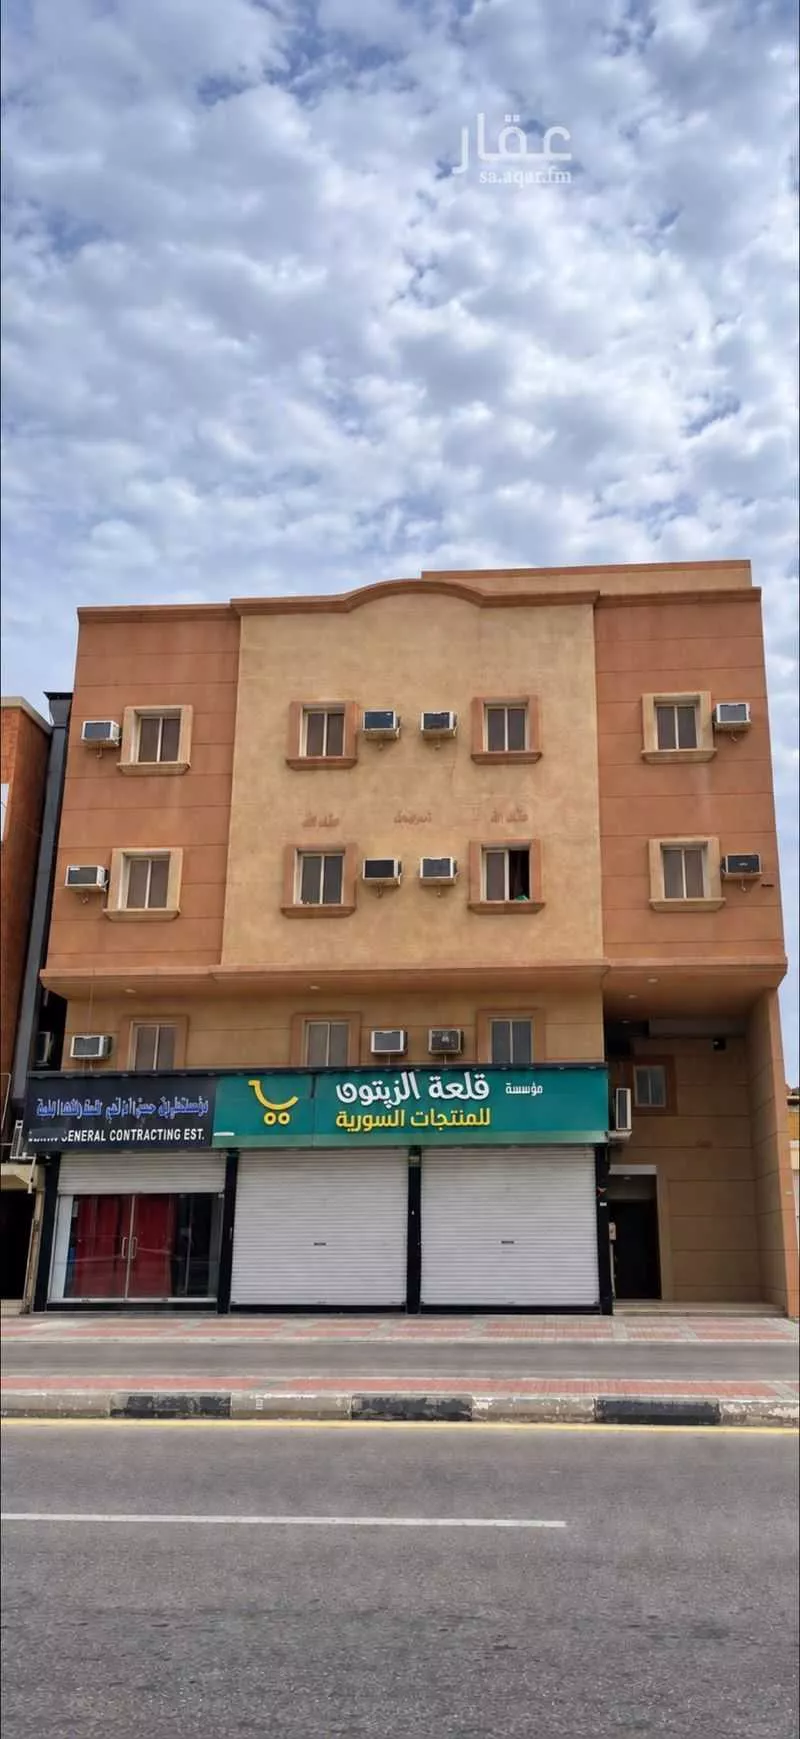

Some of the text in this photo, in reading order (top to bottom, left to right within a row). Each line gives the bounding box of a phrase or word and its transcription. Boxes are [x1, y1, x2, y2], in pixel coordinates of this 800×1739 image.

[336, 1071, 544, 1108] مؤسسة قلعة الزيتون
[336, 1108, 490, 1132] للمنتجات السورية
[109, 1128, 182, 1142] CONTRACTING
[183, 1128, 206, 1141] EST.
